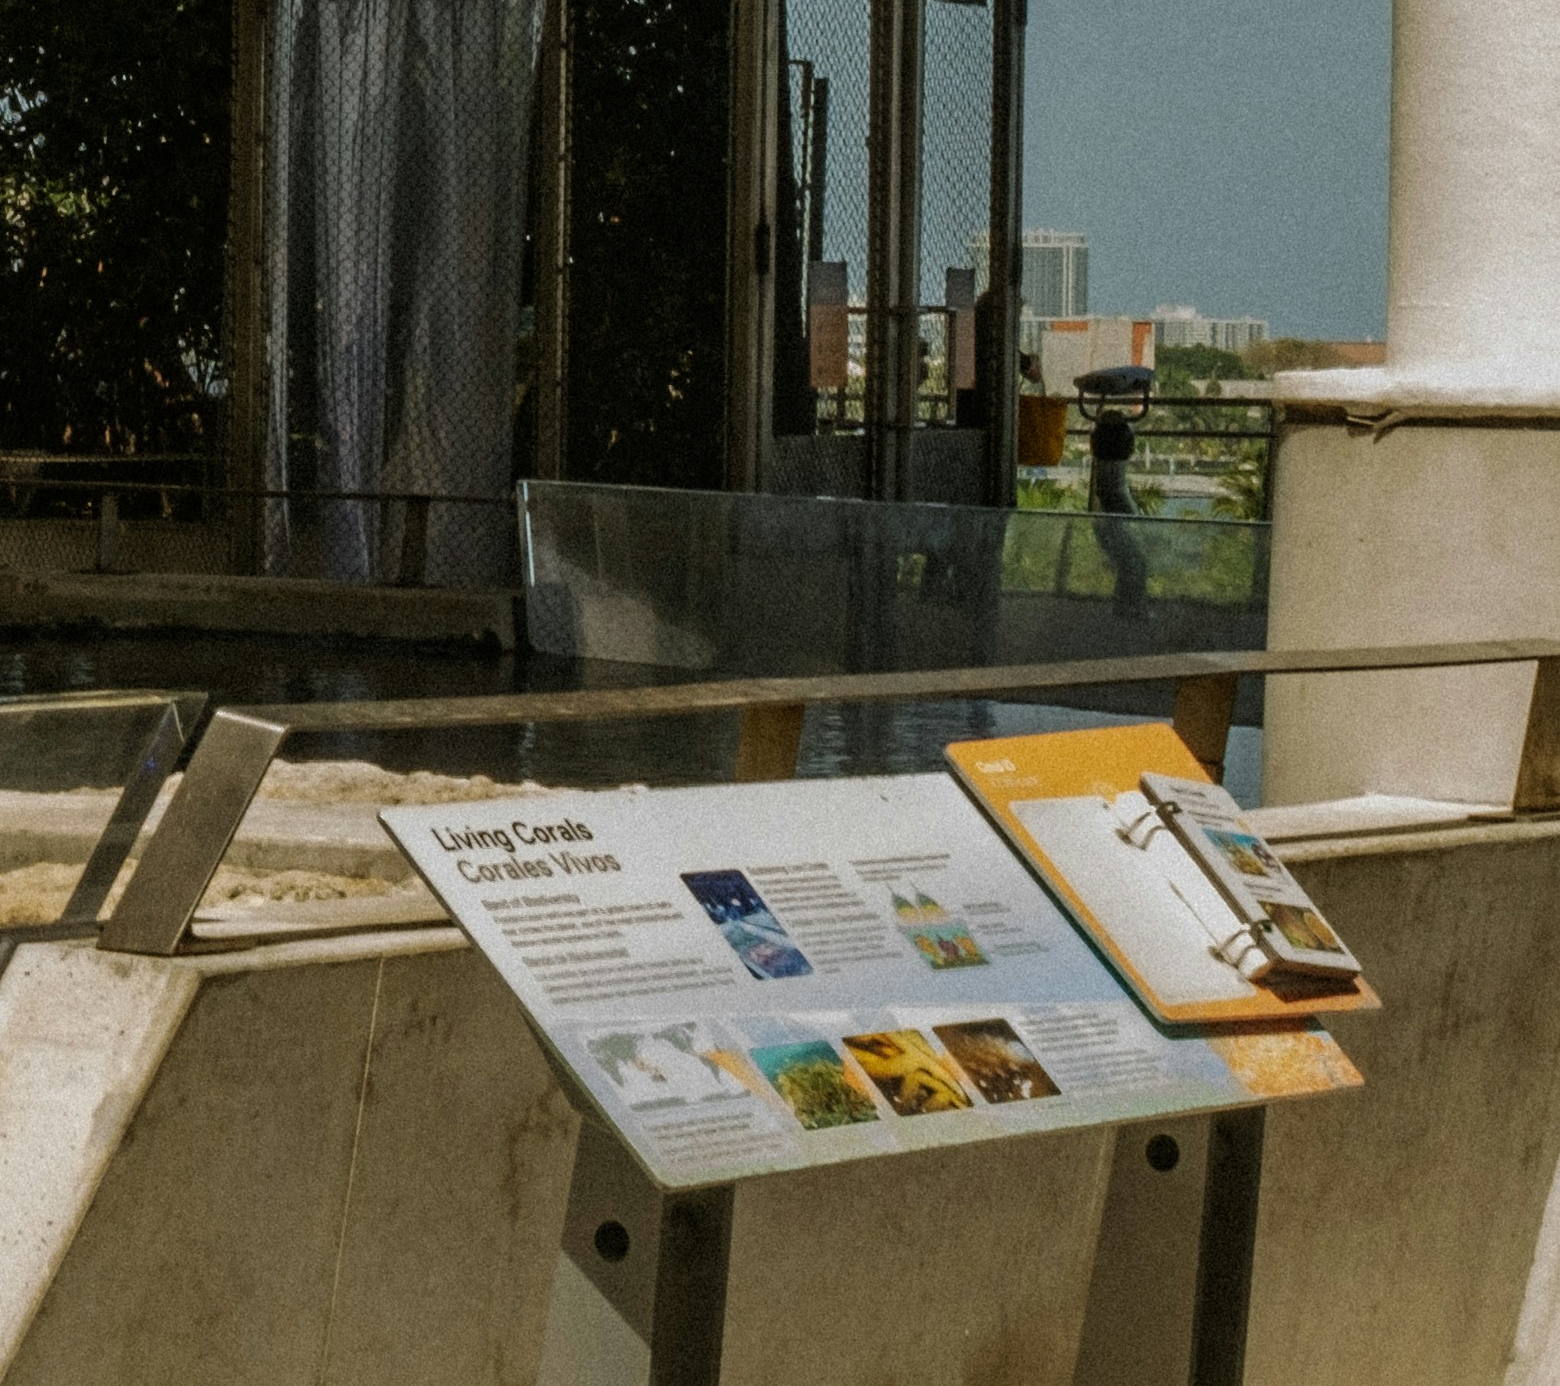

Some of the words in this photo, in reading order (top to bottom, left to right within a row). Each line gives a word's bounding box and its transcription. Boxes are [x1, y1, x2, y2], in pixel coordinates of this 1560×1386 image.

[430, 823, 516, 853] Living
[511, 818, 594, 845] Corals
[456, 855, 554, 884] Corales
[548, 852, 622, 876] Vivos
